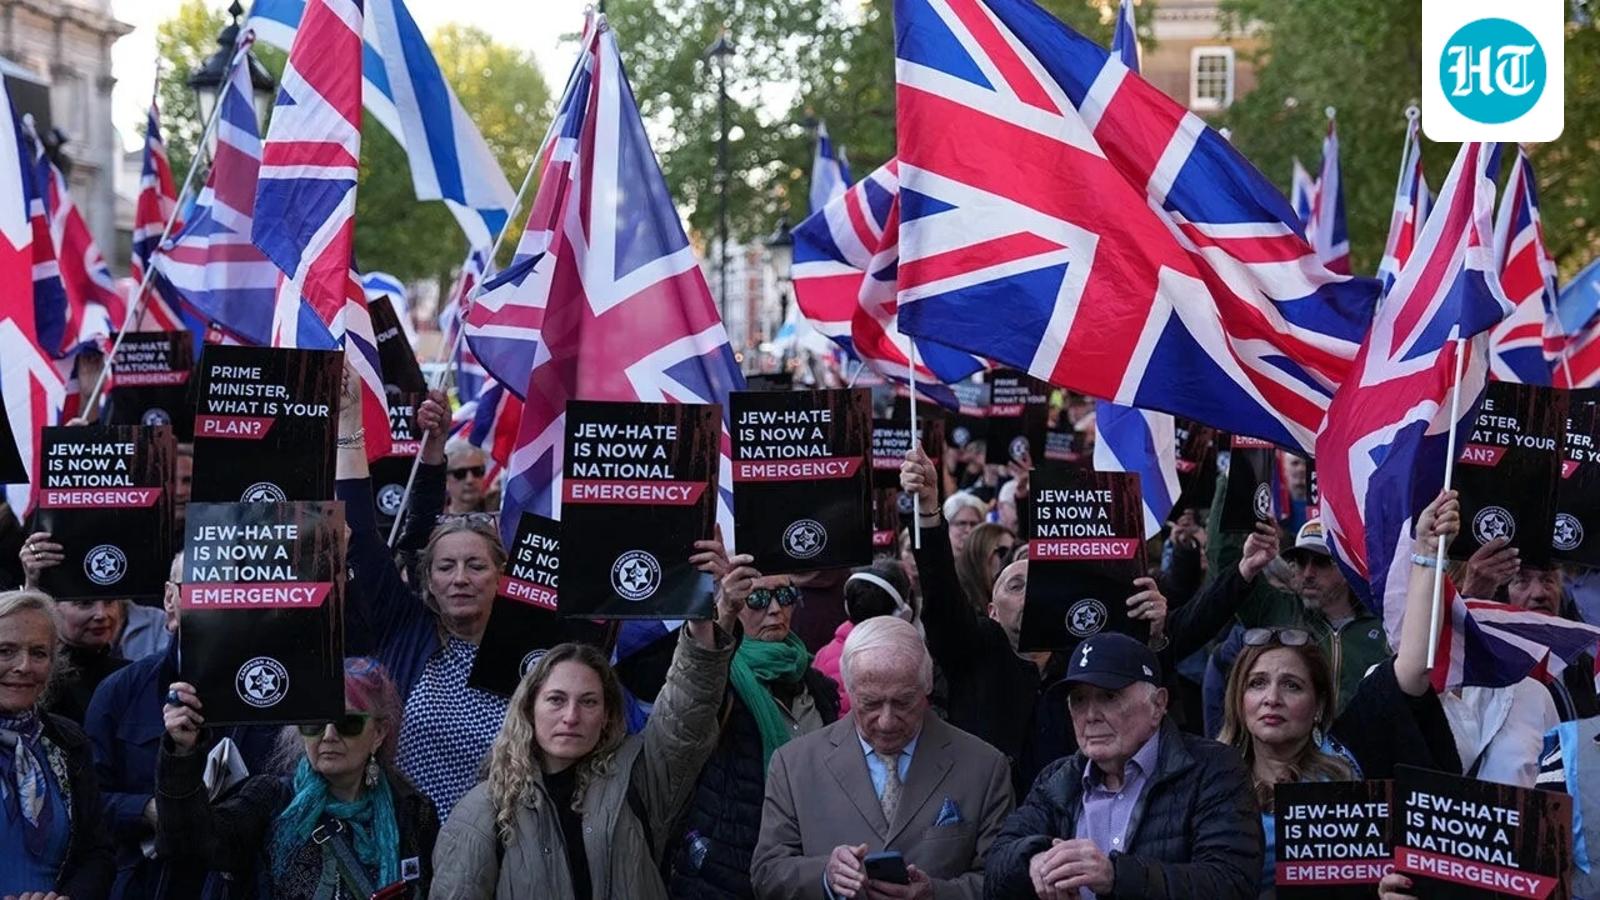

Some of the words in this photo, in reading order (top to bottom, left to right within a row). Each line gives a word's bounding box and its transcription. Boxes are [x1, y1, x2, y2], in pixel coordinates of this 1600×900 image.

[127, 352, 155, 361] NOW
[115, 362, 172, 372] NATIONAL
[211, 365, 262, 380] PRIME
[116, 373, 182, 384] EMERGENCY
[209, 383, 290, 400] MINISTER,
[208, 400, 259, 414] WHAT
[263, 403, 278, 415] IS
[283, 403, 329, 417] YOUR
[738, 409, 832, 425] JEW-HATE
[204, 420, 262, 435] PLAN?
[574, 423, 677, 440] JEW-HATE
[739, 428, 755, 441] IS
[760, 427, 806, 441] NOW
[811, 427, 824, 440] A
[1471, 429, 1492, 443] AT
[1496, 432, 1510, 445] IS
[1513, 434, 1556, 450] YOUR
[48, 443, 135, 456] JEW-HATE
[574, 442, 591, 457] IS
[597, 443, 648, 458] NOW
[652, 445, 667, 459] A
[740, 444, 833, 459] NATIONAL
[1460, 447, 1495, 462] AN?
[1571, 448, 1584, 460] IS
[48, 459, 63, 471] IS
[68, 458, 109, 471] NOW
[114, 458, 127, 471] A
[572, 463, 675, 479] NATIONAL
[740, 461, 849, 477] EMERGENCY
[48, 474, 134, 487] NATIONAL
[48, 491, 149, 505] EMERGENCY
[571, 484, 692, 500] EMERGENCY
[1036, 490, 1112, 503] JEW-HATE
[1037, 507, 1051, 519] IS
[1055, 506, 1093, 519] NOW
[1097, 507, 1108, 519] A
[193, 525, 298, 541] JEW-HATE
[1037, 524, 1116, 537] NATIONAL
[193, 545, 210, 561] IS
[217, 545, 268, 560] NOW
[274, 545, 289, 560] A
[1036, 543, 1130, 556] EMERGENCY
[517, 548, 532, 562] IS
[535, 555, 560, 570] NO
[192, 566, 298, 581] NATIONAL
[191, 587, 317, 604] EMERGENCY
[239, 660, 265, 680] CAMPAIGN
[265, 660, 286, 679] AGAINST
[1284, 803, 1390, 821] JEW-HATE
[1405, 790, 1520, 827] JEW-HATE
[1285, 824, 1302, 840] IS
[1308, 823, 1359, 839] NOW
[1366, 822, 1380, 838] A
[1406, 810, 1425, 828] IS
[1431, 815, 1487, 840] NOW
[1493, 829, 1509, 845] A
[1285, 842, 1390, 860] NATIONAL
[1406, 831, 1520, 868] NATIONAL
[1286, 863, 1395, 881] EMERGENC
[1406, 853, 1541, 895] EMERGENCY
